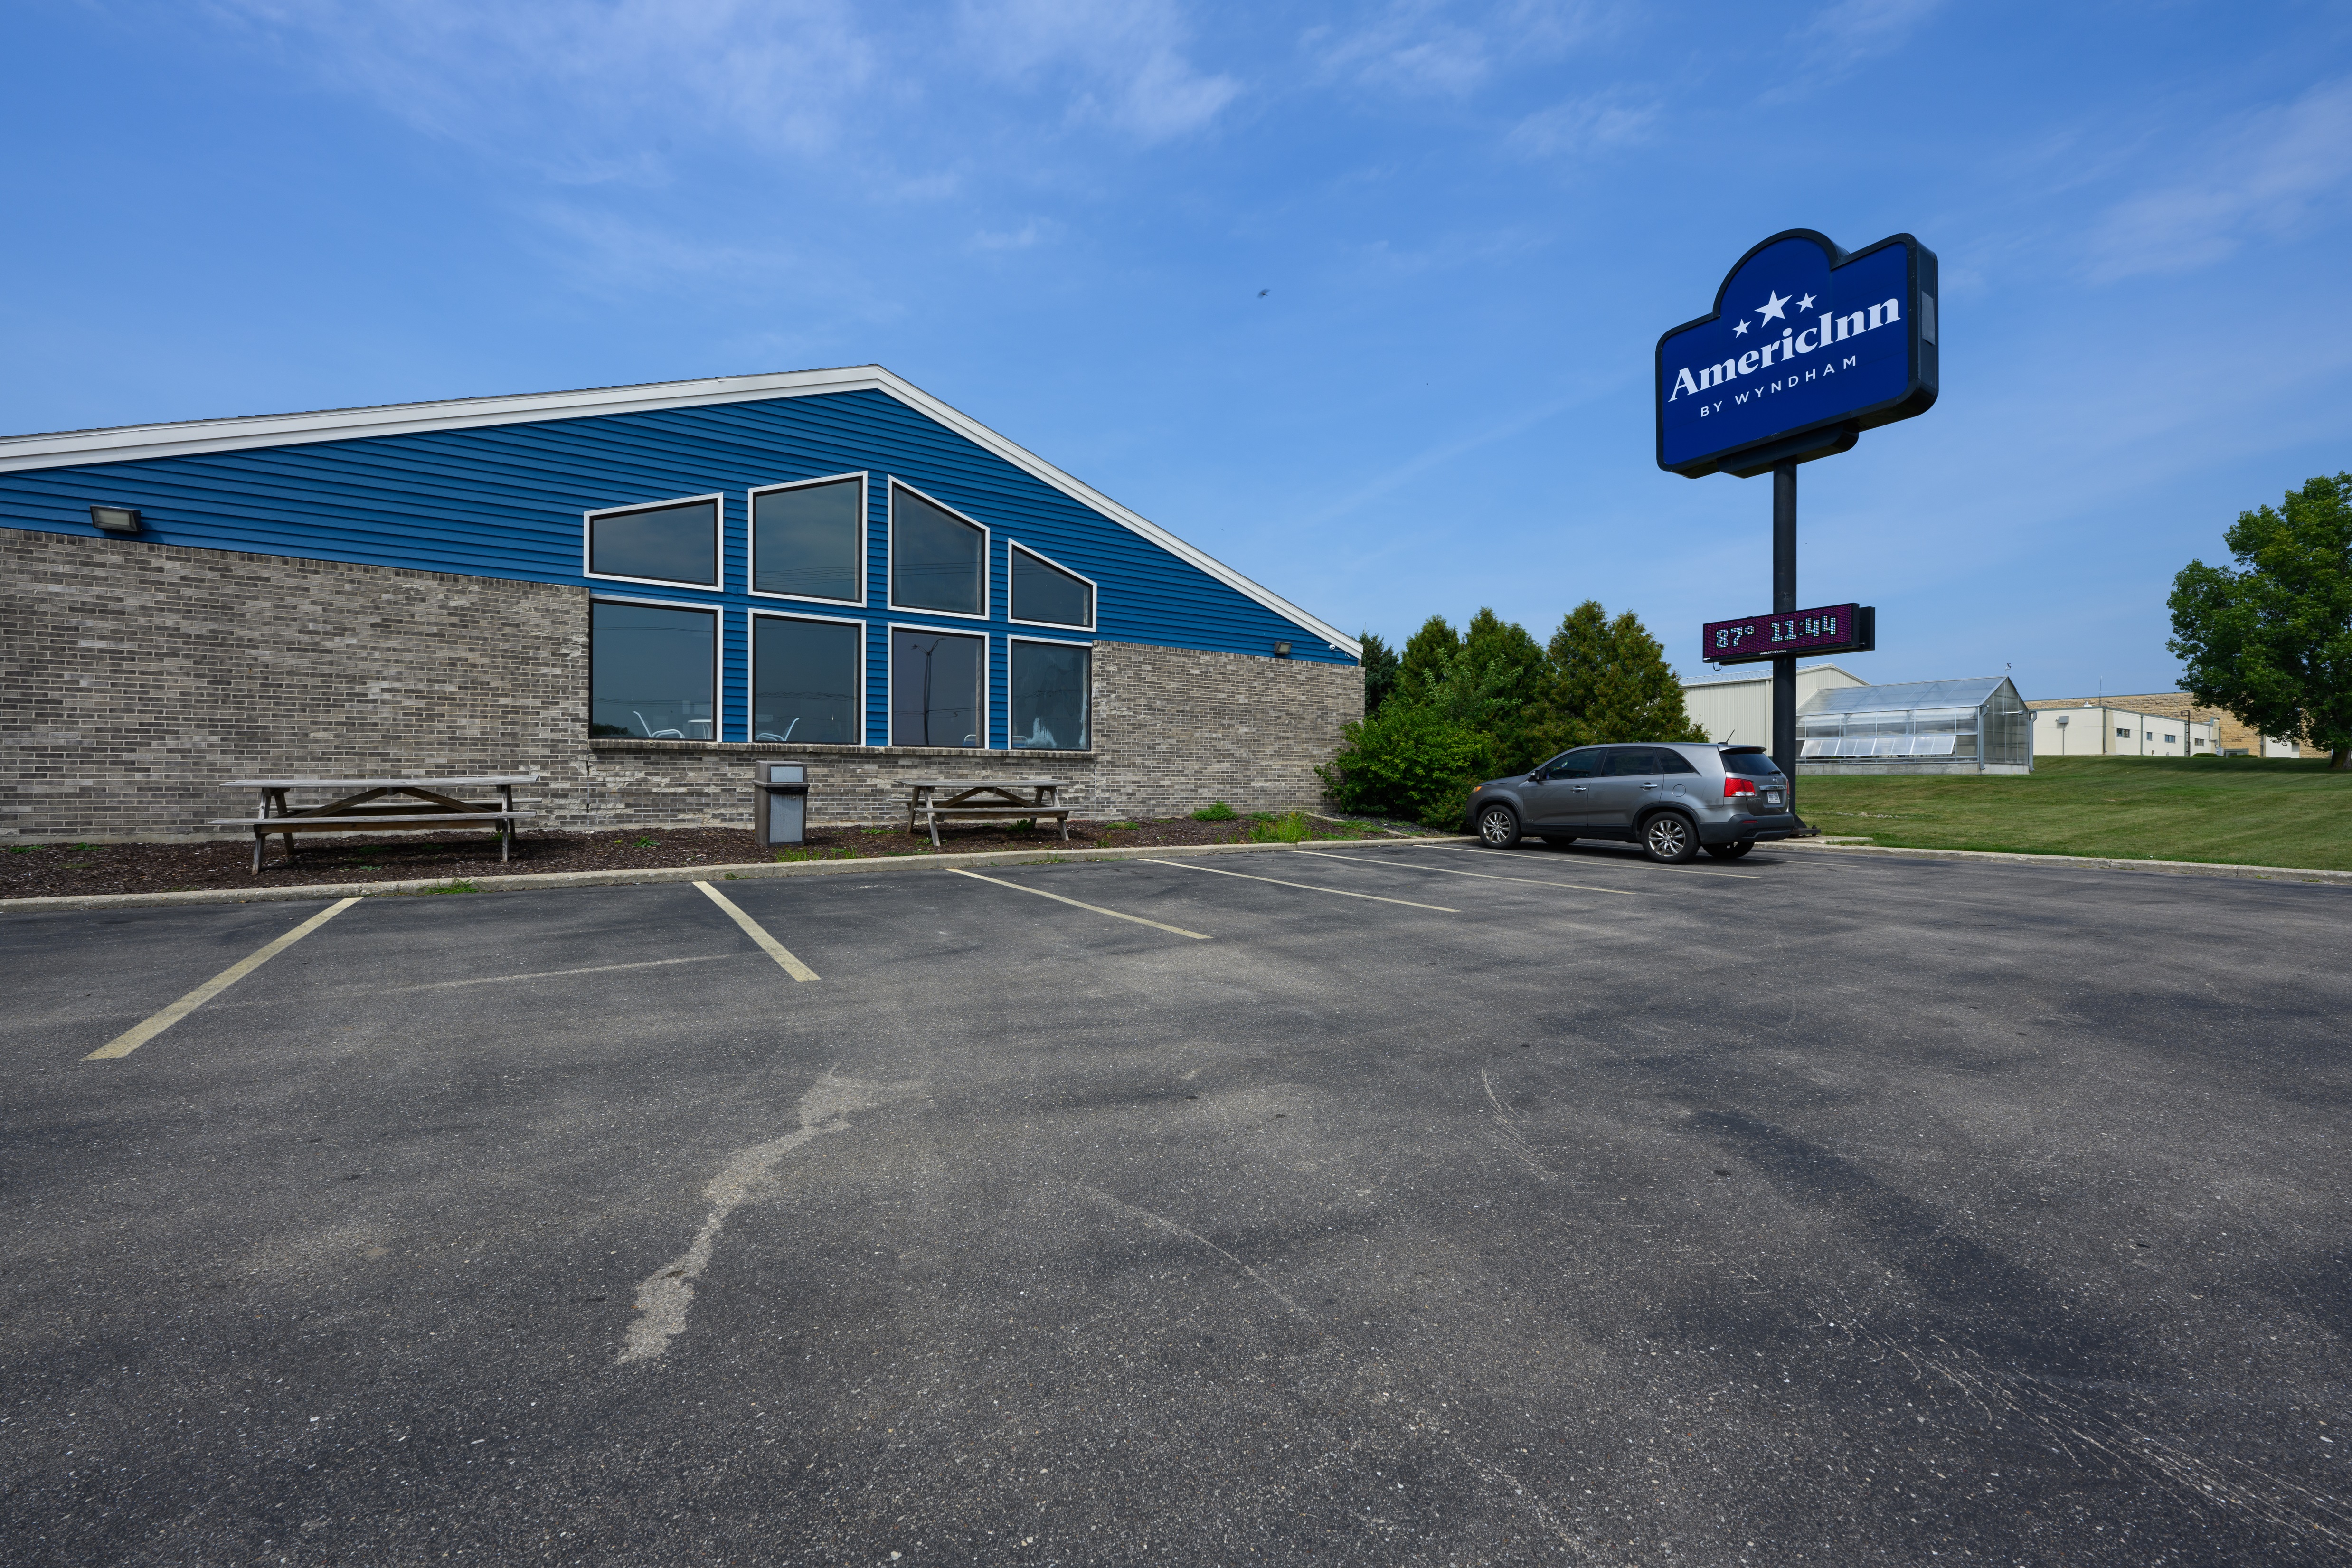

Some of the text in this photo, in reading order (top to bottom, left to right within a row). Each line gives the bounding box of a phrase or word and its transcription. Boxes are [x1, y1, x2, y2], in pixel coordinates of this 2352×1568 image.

[1668, 298, 1901, 402] AmericInn
[1700, 355, 1856, 417] BY WYNDHAM
[1771, 615, 1836, 642] 11:44
